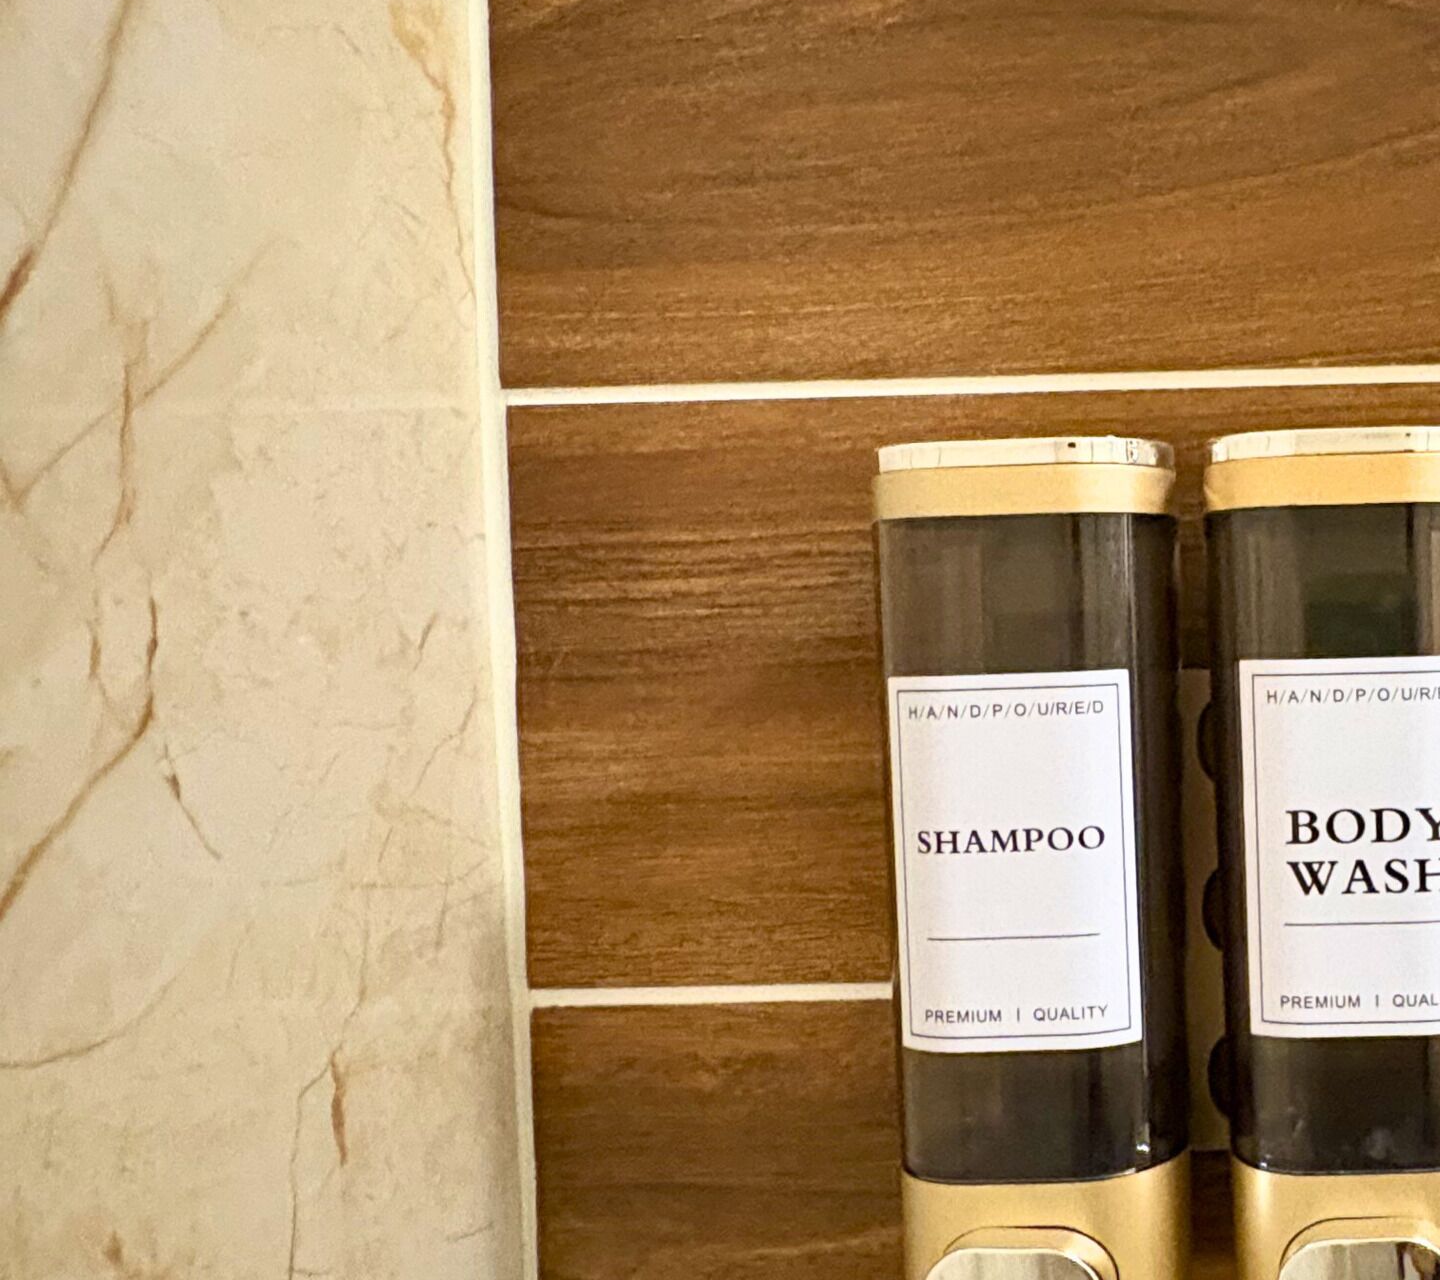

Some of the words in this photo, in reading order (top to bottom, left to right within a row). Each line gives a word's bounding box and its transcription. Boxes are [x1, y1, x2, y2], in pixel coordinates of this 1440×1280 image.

[917, 825, 1105, 855] SHAMPOO
[1280, 994, 1361, 1010] PREMIUM
[925, 1008, 1002, 1023] PREMIUM
[1033, 1003, 1109, 1022] QUALITY
